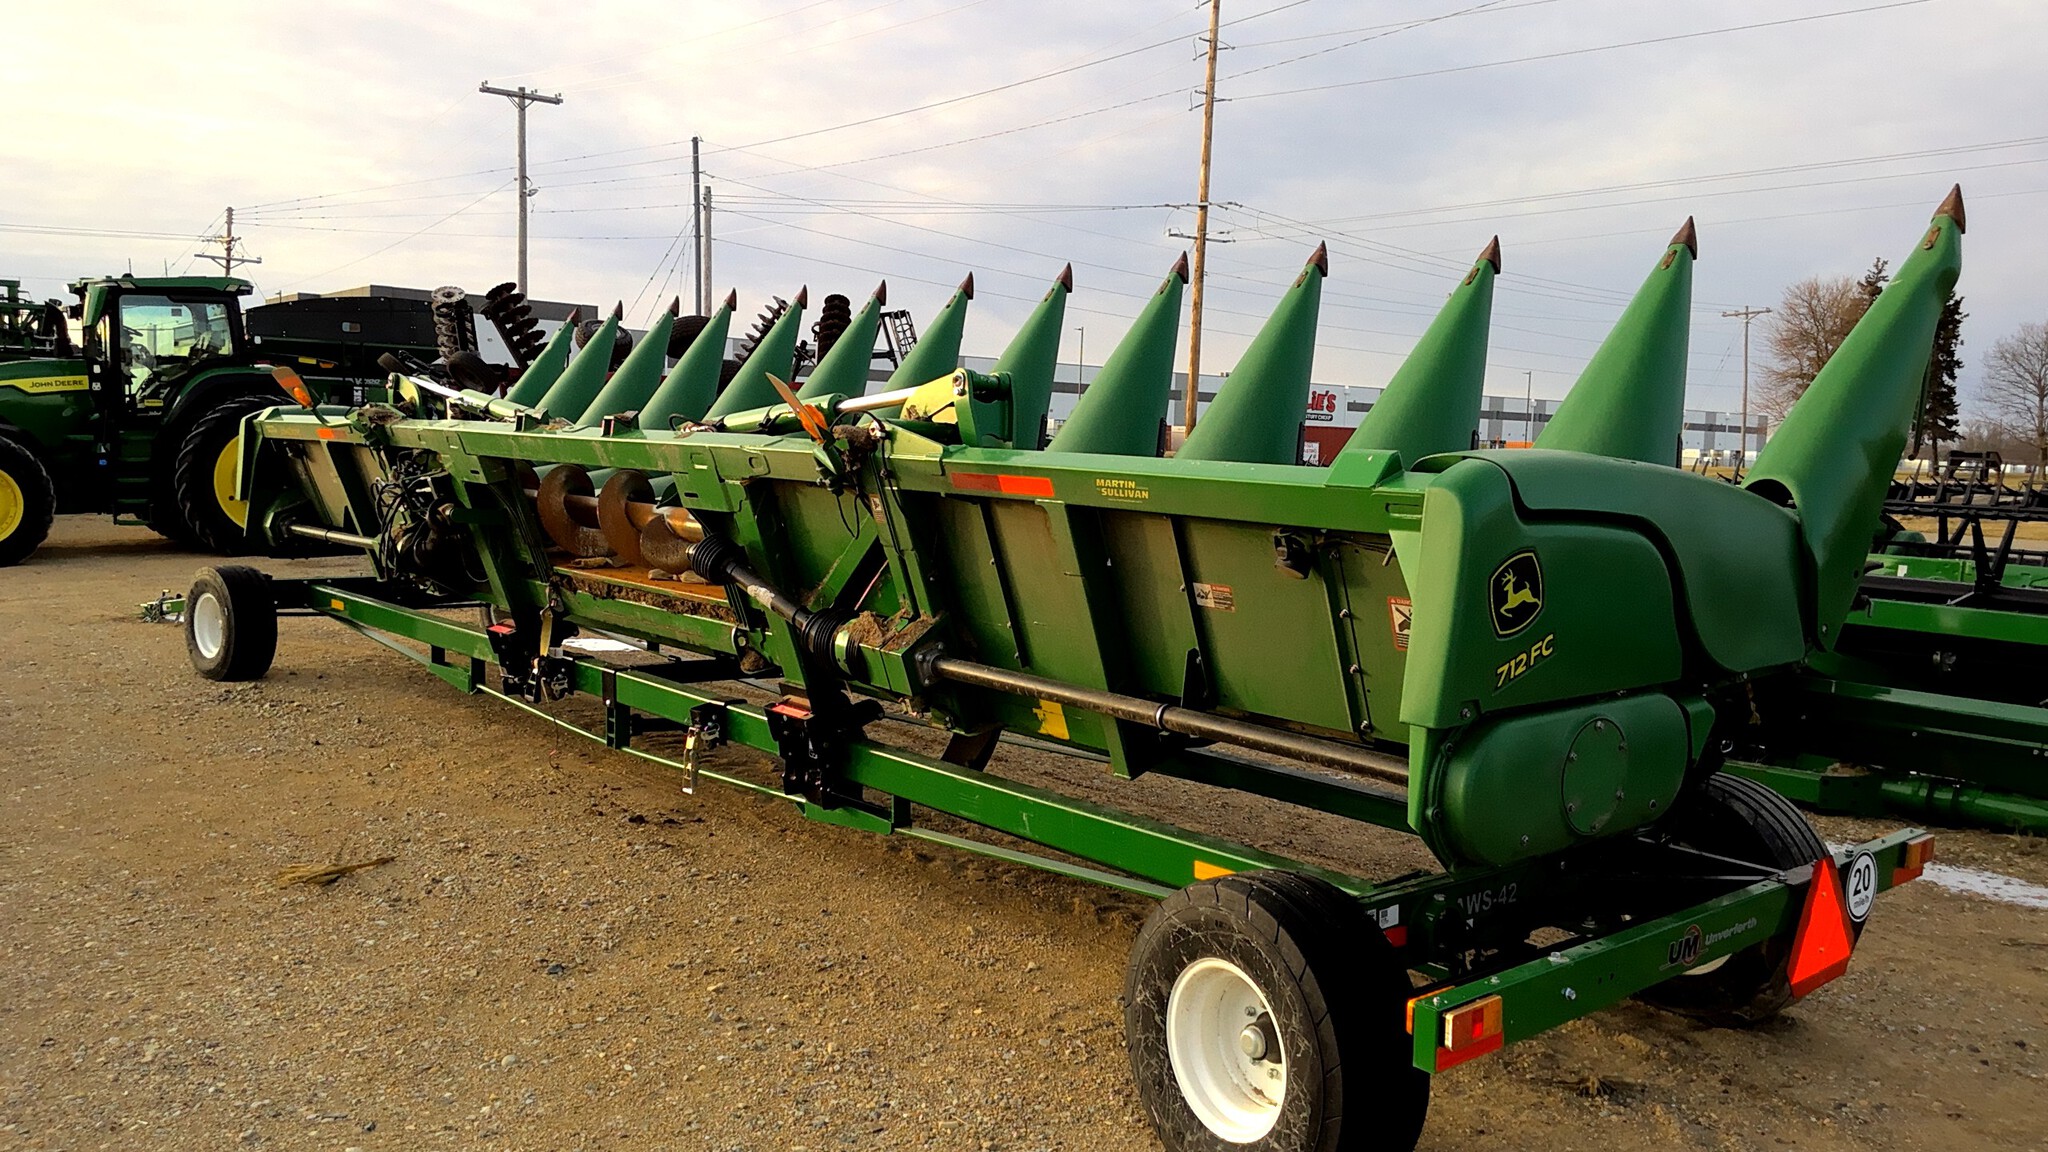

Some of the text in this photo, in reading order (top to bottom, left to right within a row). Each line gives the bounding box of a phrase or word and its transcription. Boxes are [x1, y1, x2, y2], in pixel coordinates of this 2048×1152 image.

[29, 379, 85, 389] JOHN DEERE
[1096, 478, 1136, 489] MARTIN
[1101, 487, 1149, 499] SULLIVAN
[1852, 863, 1871, 897] 20
